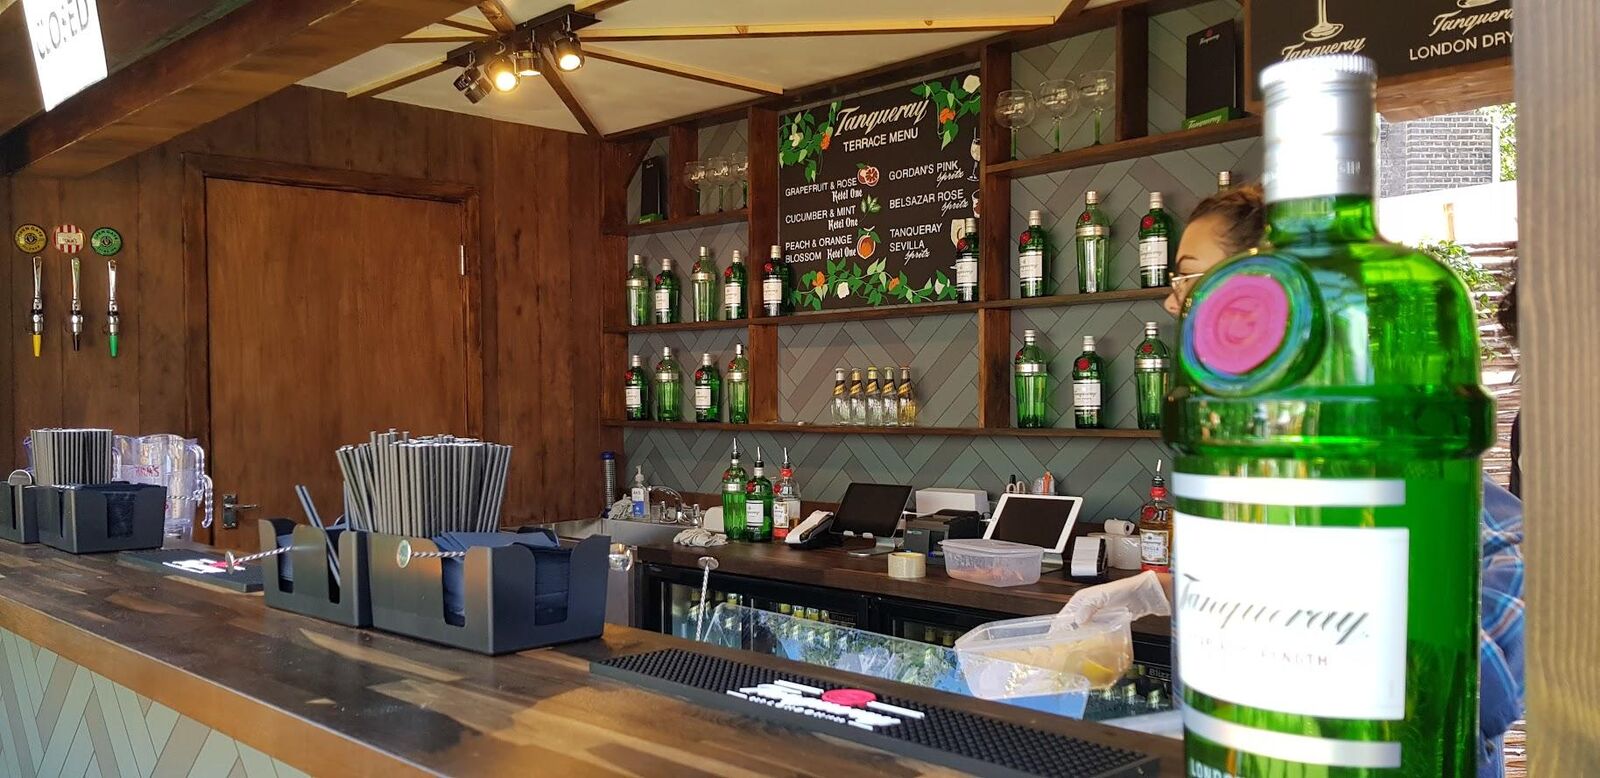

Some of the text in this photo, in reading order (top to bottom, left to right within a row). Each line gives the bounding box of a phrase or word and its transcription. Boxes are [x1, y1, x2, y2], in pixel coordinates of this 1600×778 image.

[1428, 7, 1514, 37] Tanquera
[1281, 37, 1367, 63] Tanqueray
[1409, 30, 1515, 61] LONDON DRY
[834, 99, 930, 137] Tanqueray
[843, 127, 919, 152] TERRACE MENU
[888, 160, 959, 181] GORDAN'S PINK
[785, 177, 858, 197] GRAPEFRUIT & ROSE
[850, 188, 863, 199] One
[889, 189, 964, 209] BELSAZAR ROSE
[785, 205, 856, 224] CUCUMBER & MINT
[845, 217, 859, 227] One
[889, 222, 943, 238] TANQUERAY
[785, 234, 852, 251] PEACH & ORANGE
[889, 239, 925, 253] SEVILLA
[785, 251, 822, 263] BLOSSOM
[844, 246, 857, 258] One
